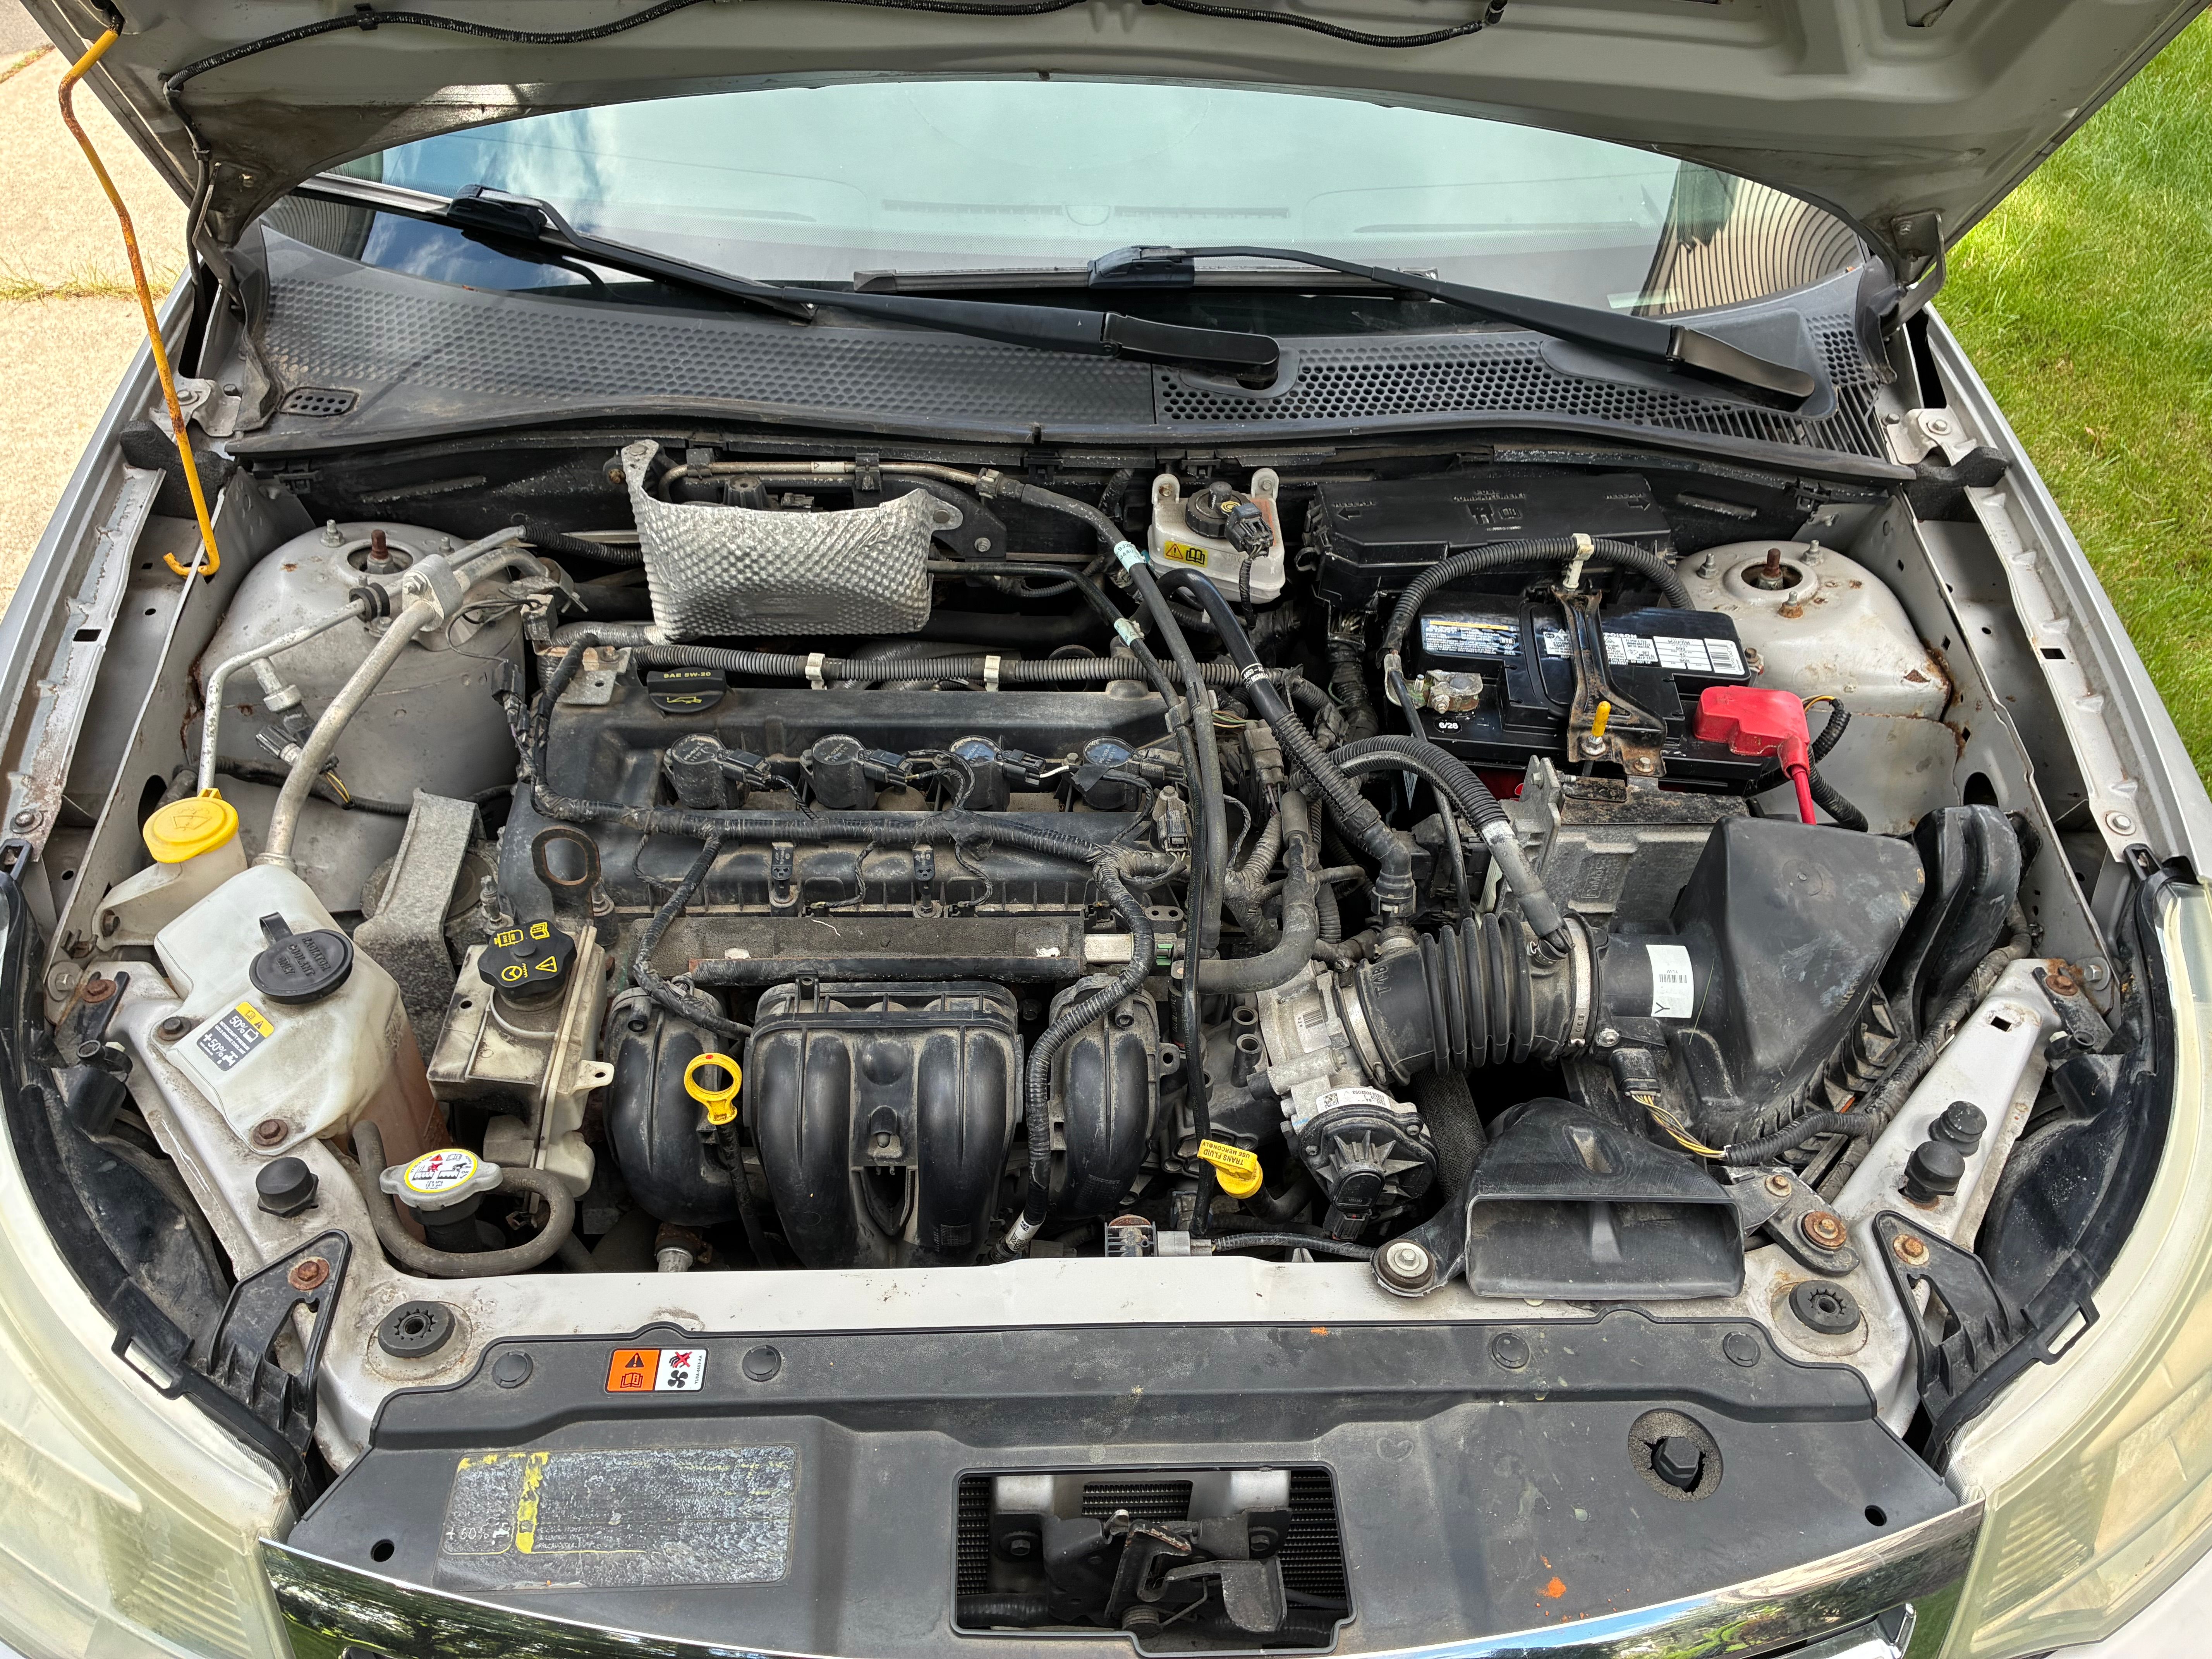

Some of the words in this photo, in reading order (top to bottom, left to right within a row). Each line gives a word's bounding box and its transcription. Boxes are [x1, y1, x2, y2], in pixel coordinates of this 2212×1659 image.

[287, 944, 315, 976] COOLANT
[302, 936, 331, 972] RADIATOR
[277, 957, 295, 975] ONLY
[1654, 1001, 1671, 1014] Y
[229, 1015, 248, 1034] 50%
[1203, 1149, 1222, 1159] FLUID
[1223, 1154, 1243, 1166] TRANS
